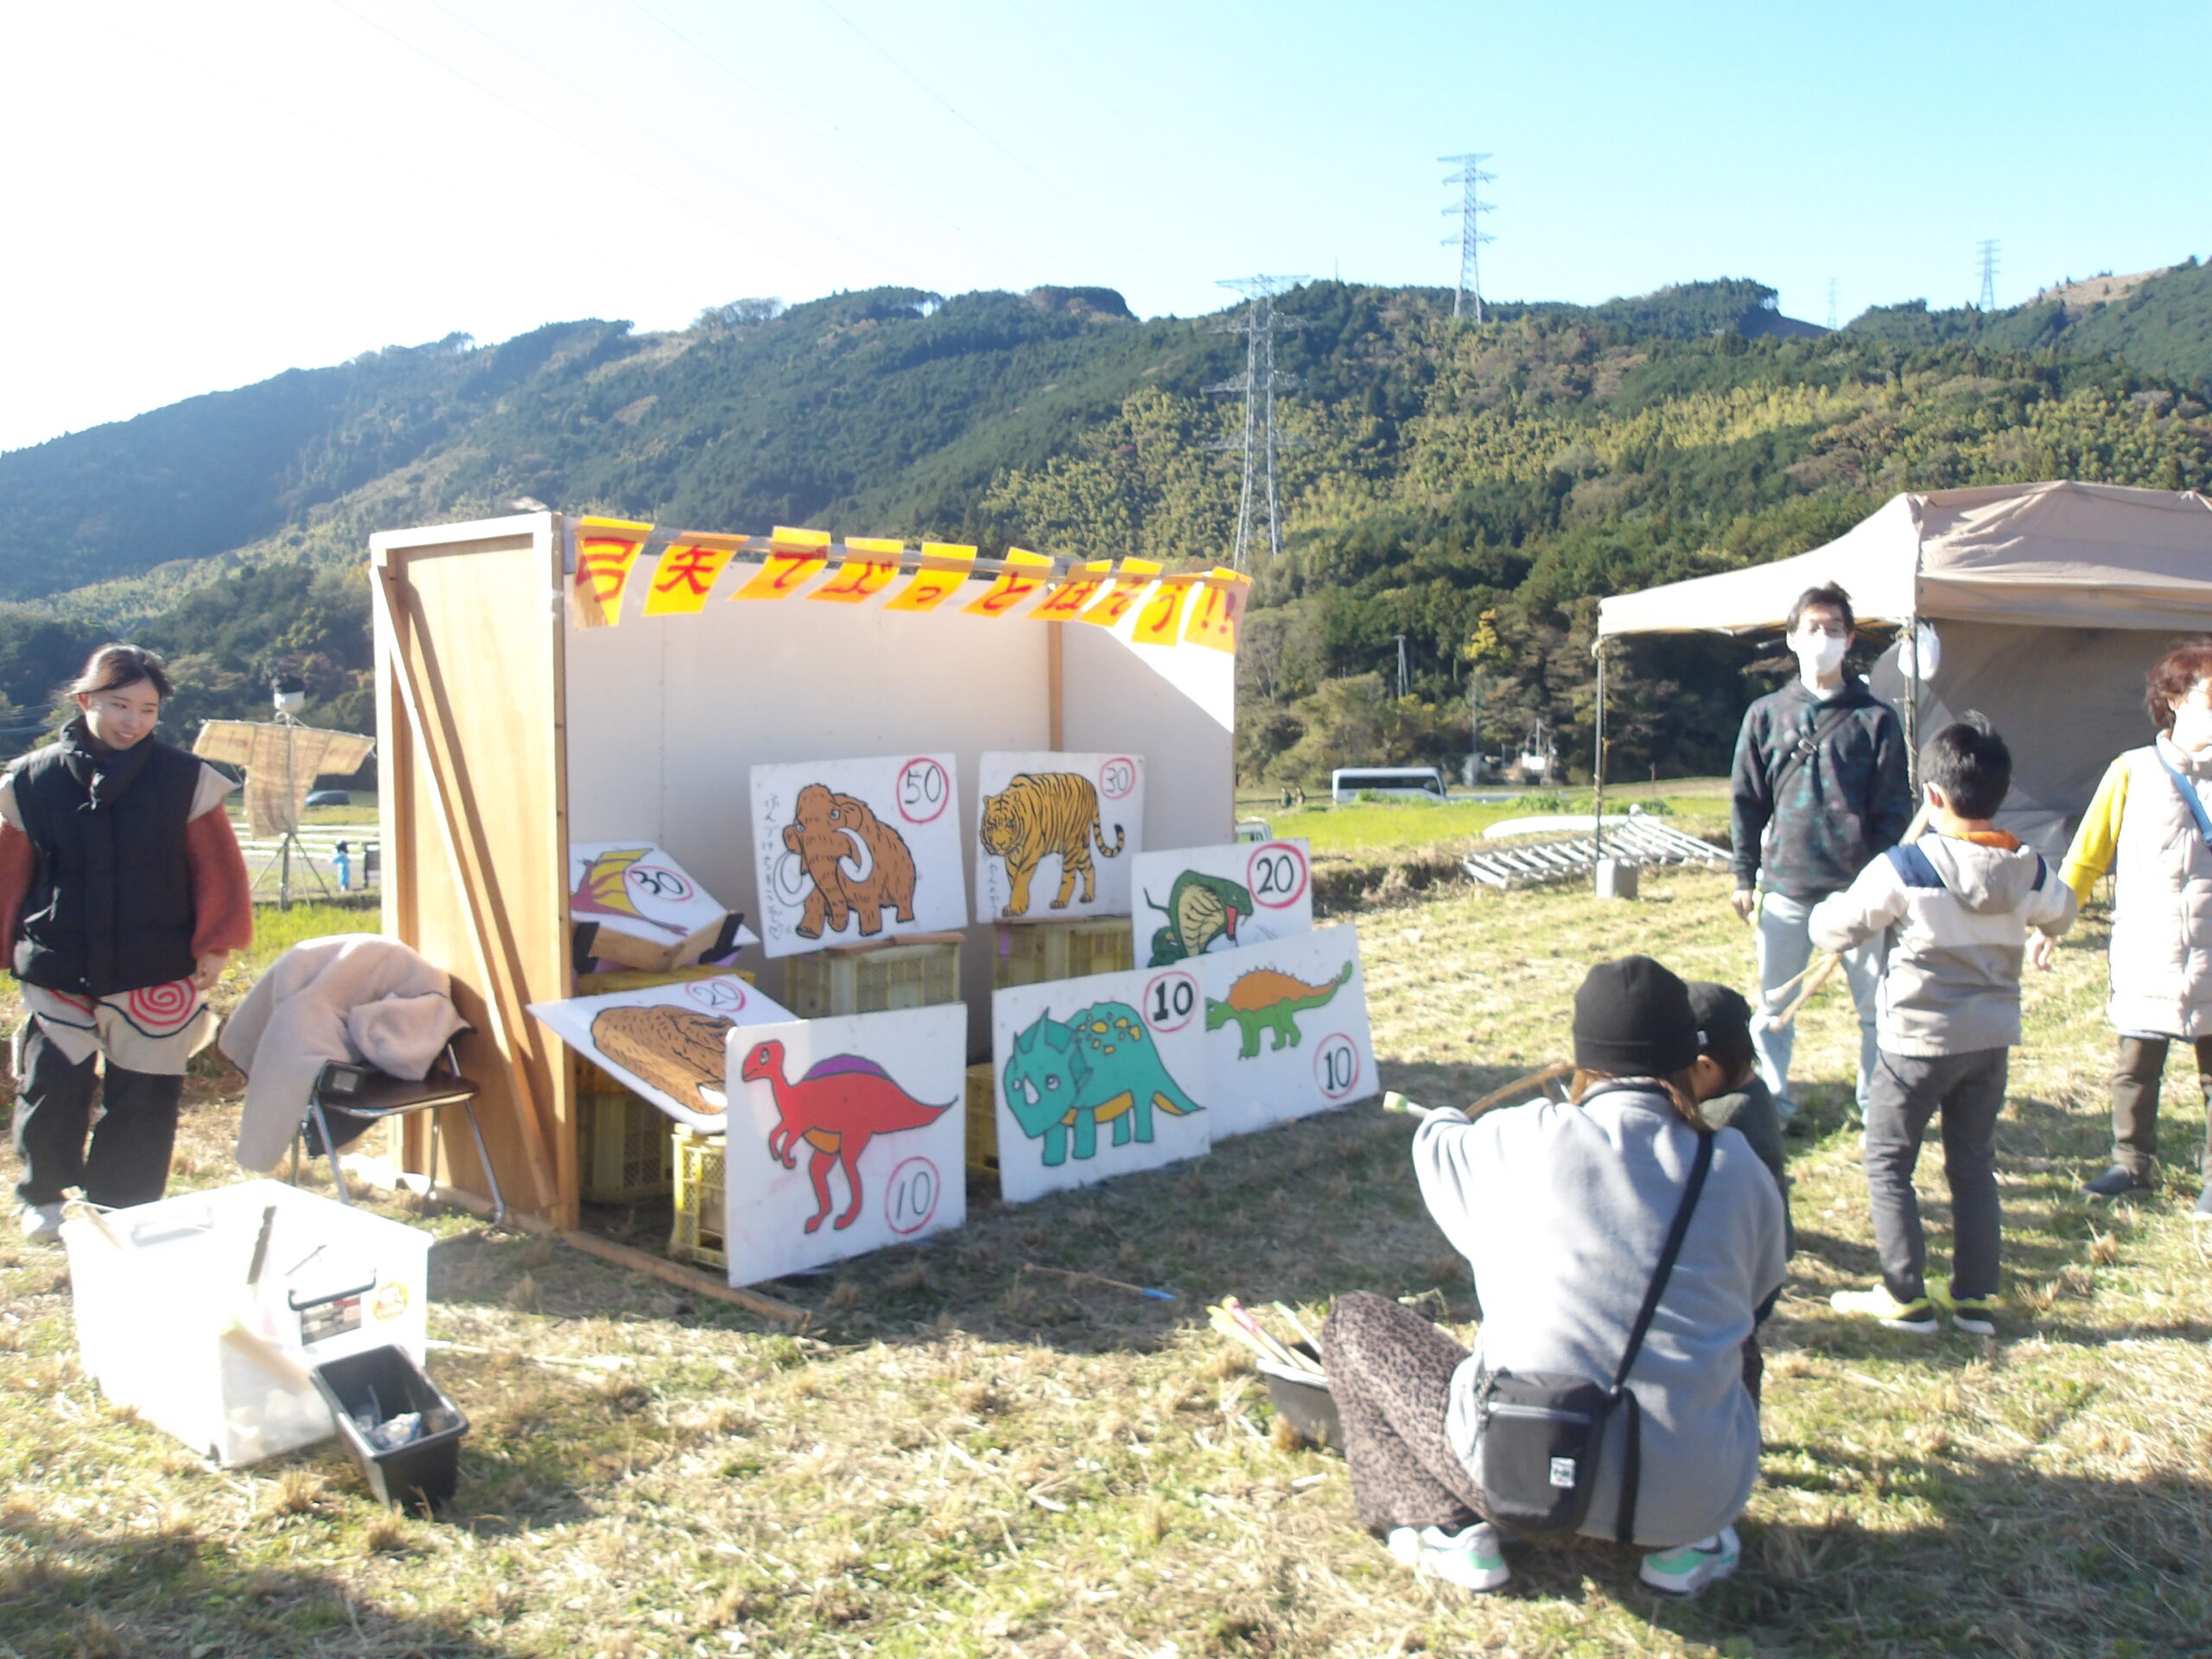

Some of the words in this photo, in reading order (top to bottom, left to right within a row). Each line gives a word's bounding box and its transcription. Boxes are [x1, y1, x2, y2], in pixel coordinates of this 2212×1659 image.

[904, 765, 942, 804] 50
[1106, 766, 1129, 793] 30
[630, 871, 683, 894] 30
[1256, 855, 1294, 895] 20
[692, 982, 739, 1006] 20
[1153, 980, 1194, 1022] 10
[1324, 1046, 1351, 1090] 10
[896, 1171, 931, 1219] 10
